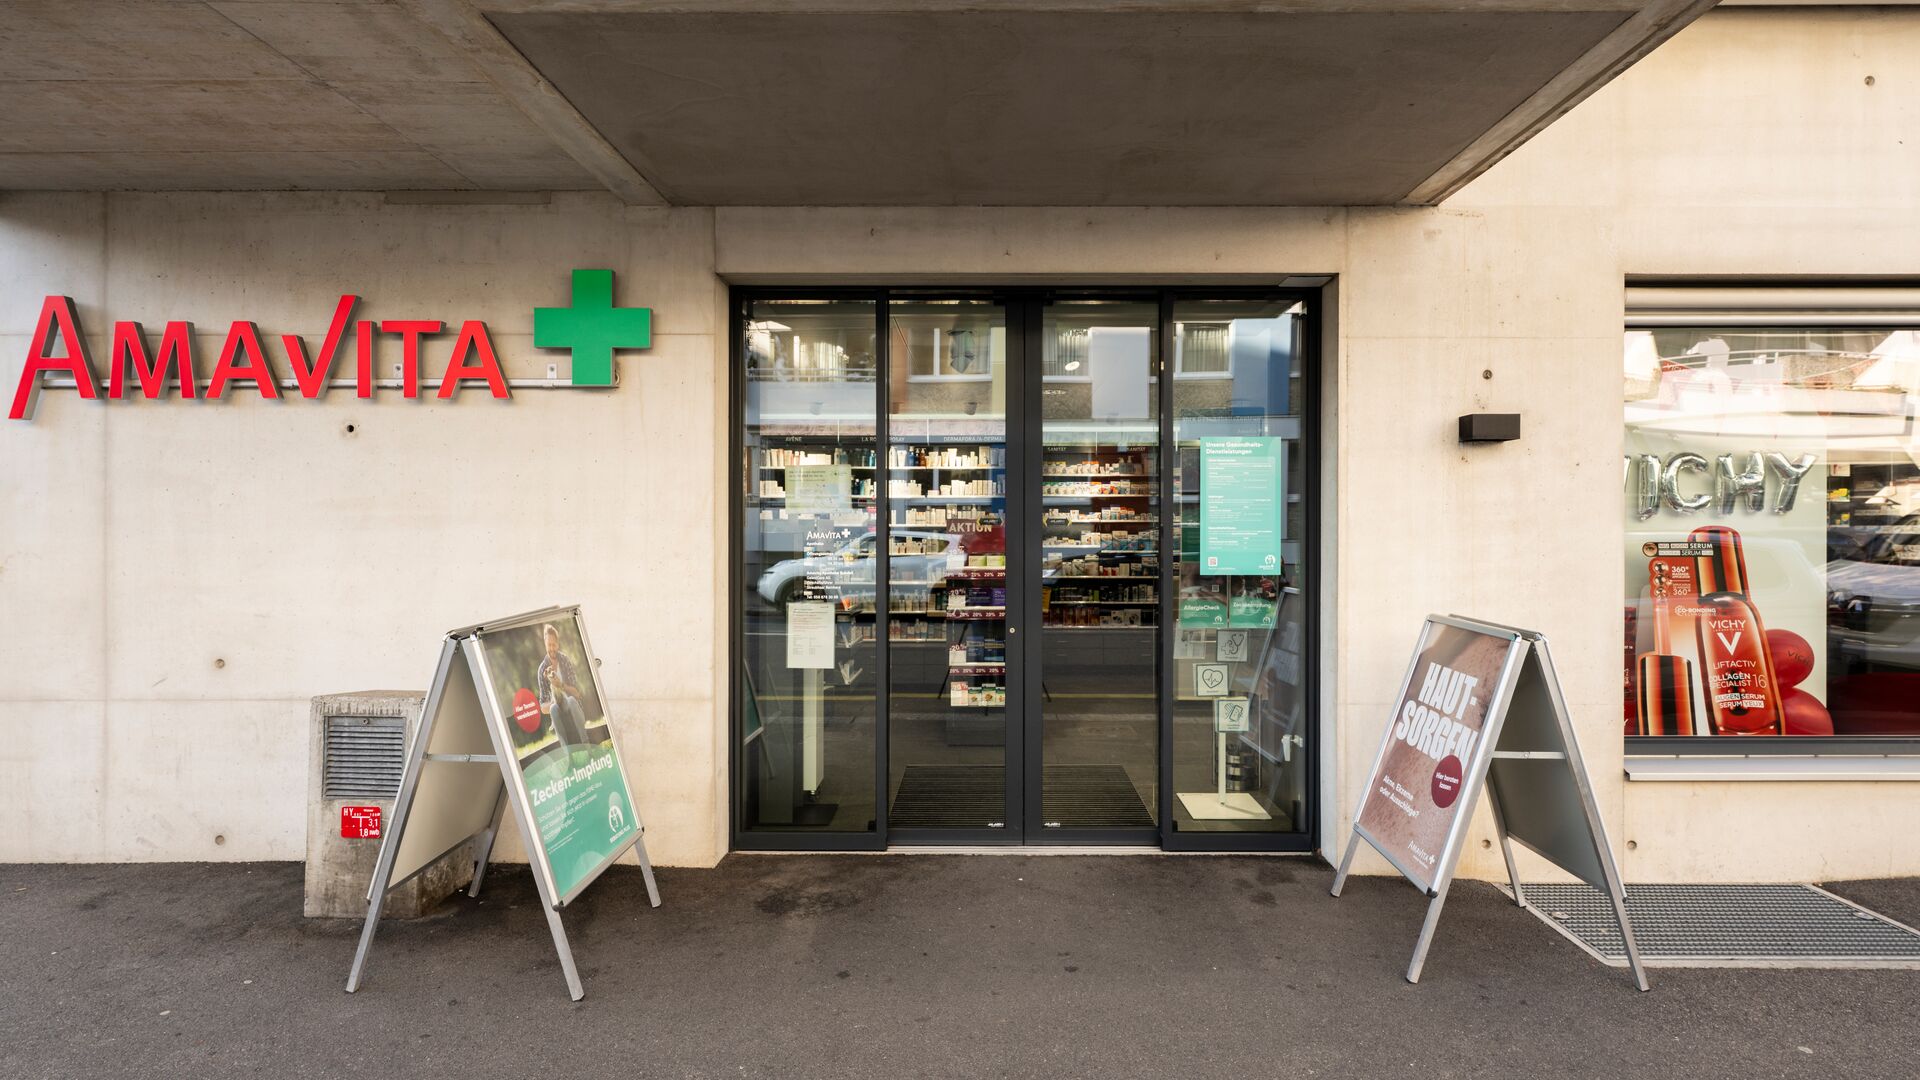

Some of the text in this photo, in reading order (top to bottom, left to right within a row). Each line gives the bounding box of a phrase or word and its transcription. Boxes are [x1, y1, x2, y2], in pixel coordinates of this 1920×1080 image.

[8, 294, 512, 420] AMAVITA
[948, 522, 992, 533] AKTION
[806, 530, 841, 540] AMAVITA
[1709, 620, 1746, 629] VICHY
[1713, 660, 1756, 670] LIFTACTIV
[1752, 674, 1767, 689] 16
[1418, 662, 1478, 720] HAUT-
[1741, 693, 1765, 701] SERUM
[1720, 700, 1743, 709] SERUM
[1396, 700, 1478, 773] SORGEN
[530, 754, 613, 807] Zecken-Impfung
[368, 818, 378, 828] 3,1
[359, 828, 368, 837] 1,8
